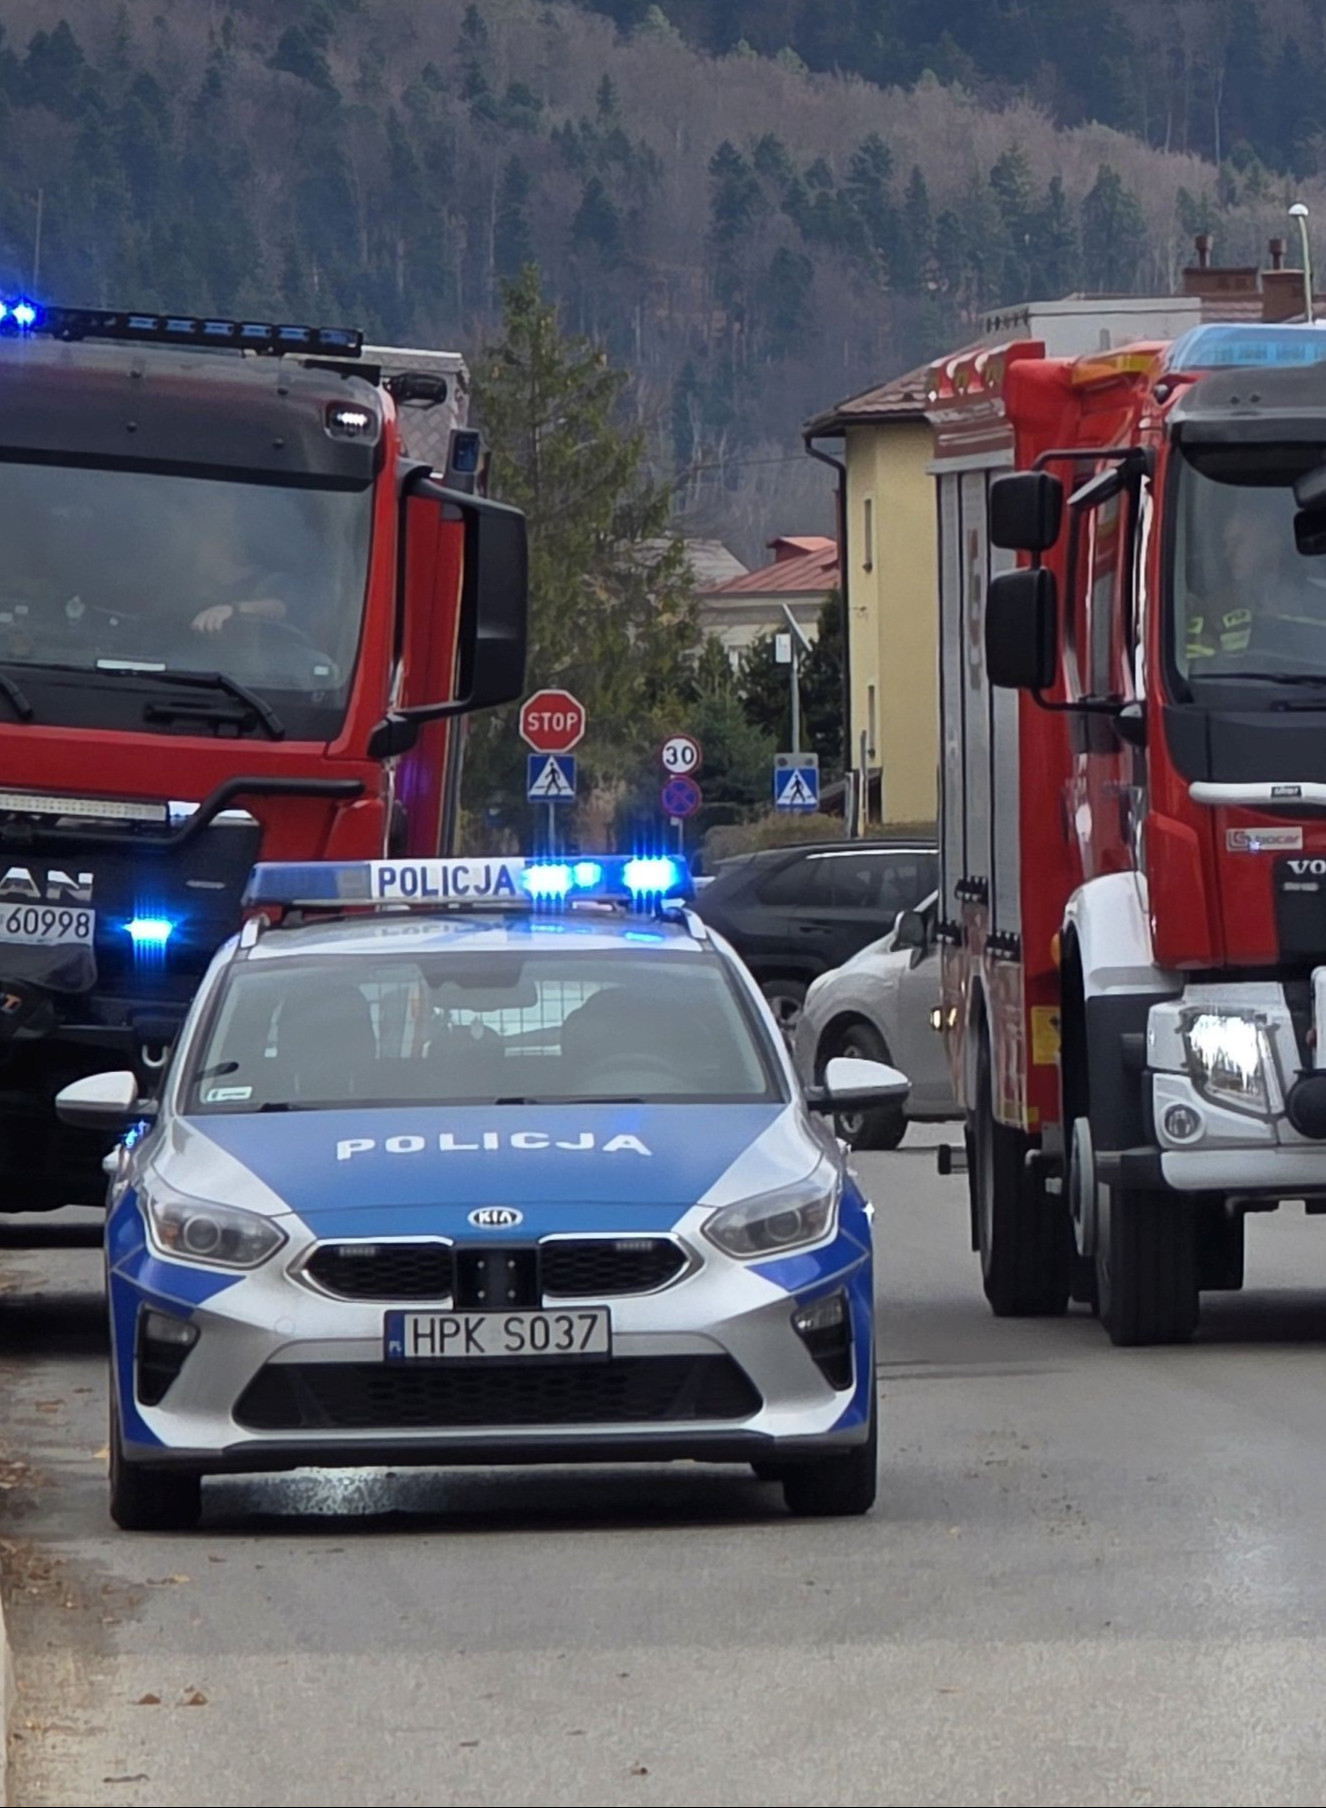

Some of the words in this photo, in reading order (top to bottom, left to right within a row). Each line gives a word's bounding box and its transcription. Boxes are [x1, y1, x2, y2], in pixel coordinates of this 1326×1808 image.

[527, 712, 579, 733] STOP
[664, 746, 695, 766] 30
[0, 866, 94, 901] AN
[378, 864, 517, 897] POLICJA
[6, 907, 90, 938] 60998
[336, 1132, 653, 1160] POLICJA
[478, 1210, 514, 1225] KIA
[413, 1317, 486, 1354] HPK
[503, 1313, 598, 1352] S037
